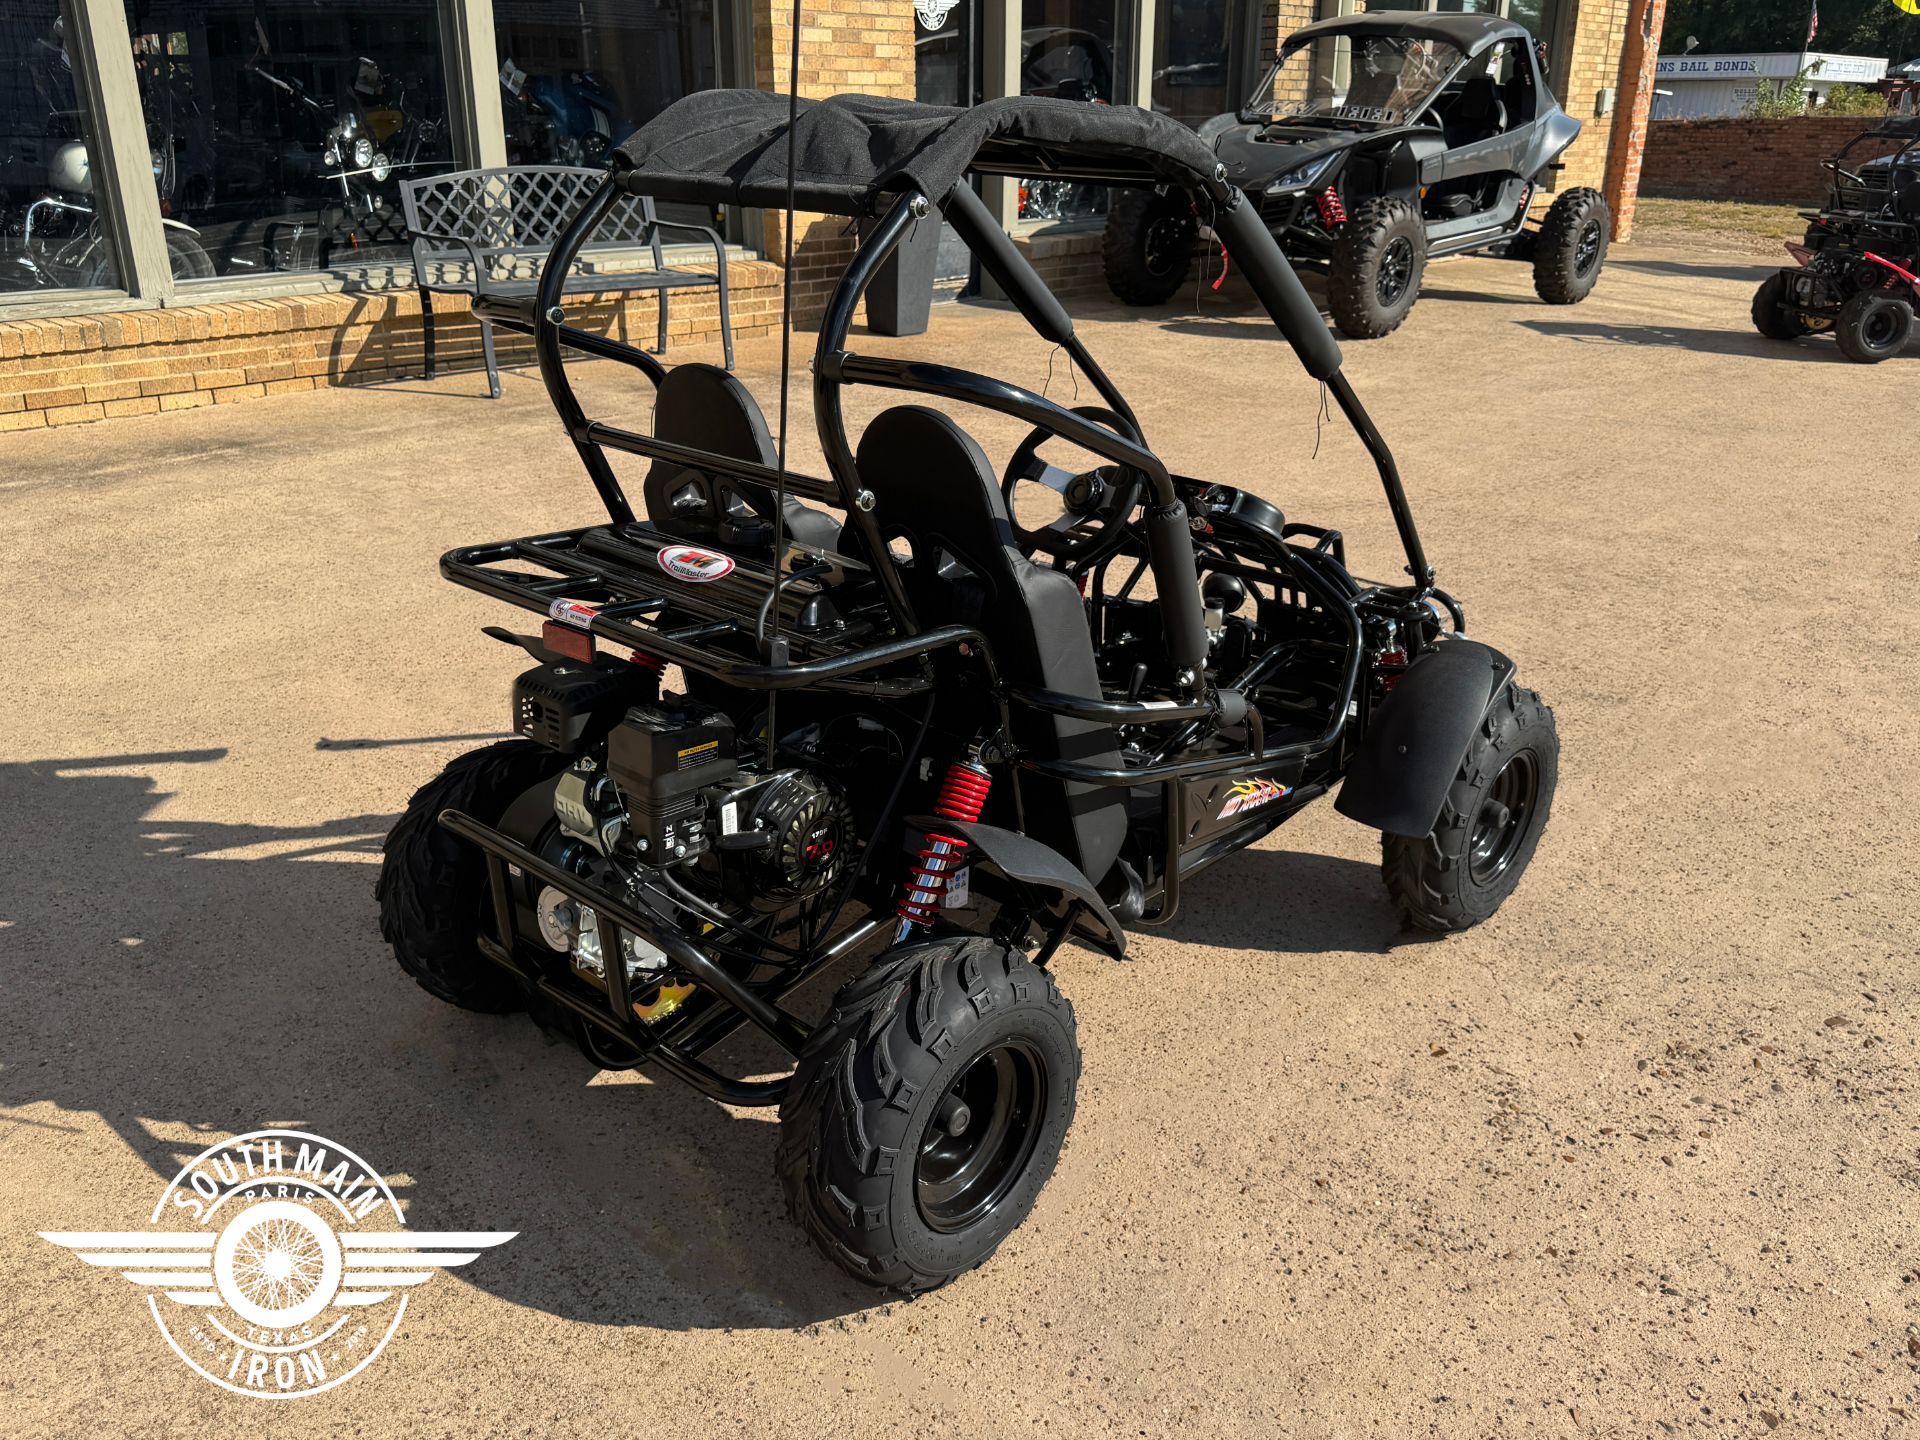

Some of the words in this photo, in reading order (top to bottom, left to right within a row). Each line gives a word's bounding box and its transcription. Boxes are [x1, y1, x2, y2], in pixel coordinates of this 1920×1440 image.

[1680, 61, 1708, 71] BAIL
[1714, 61, 1756, 71] BONDS
[669, 560, 710, 578] TrailMaster
